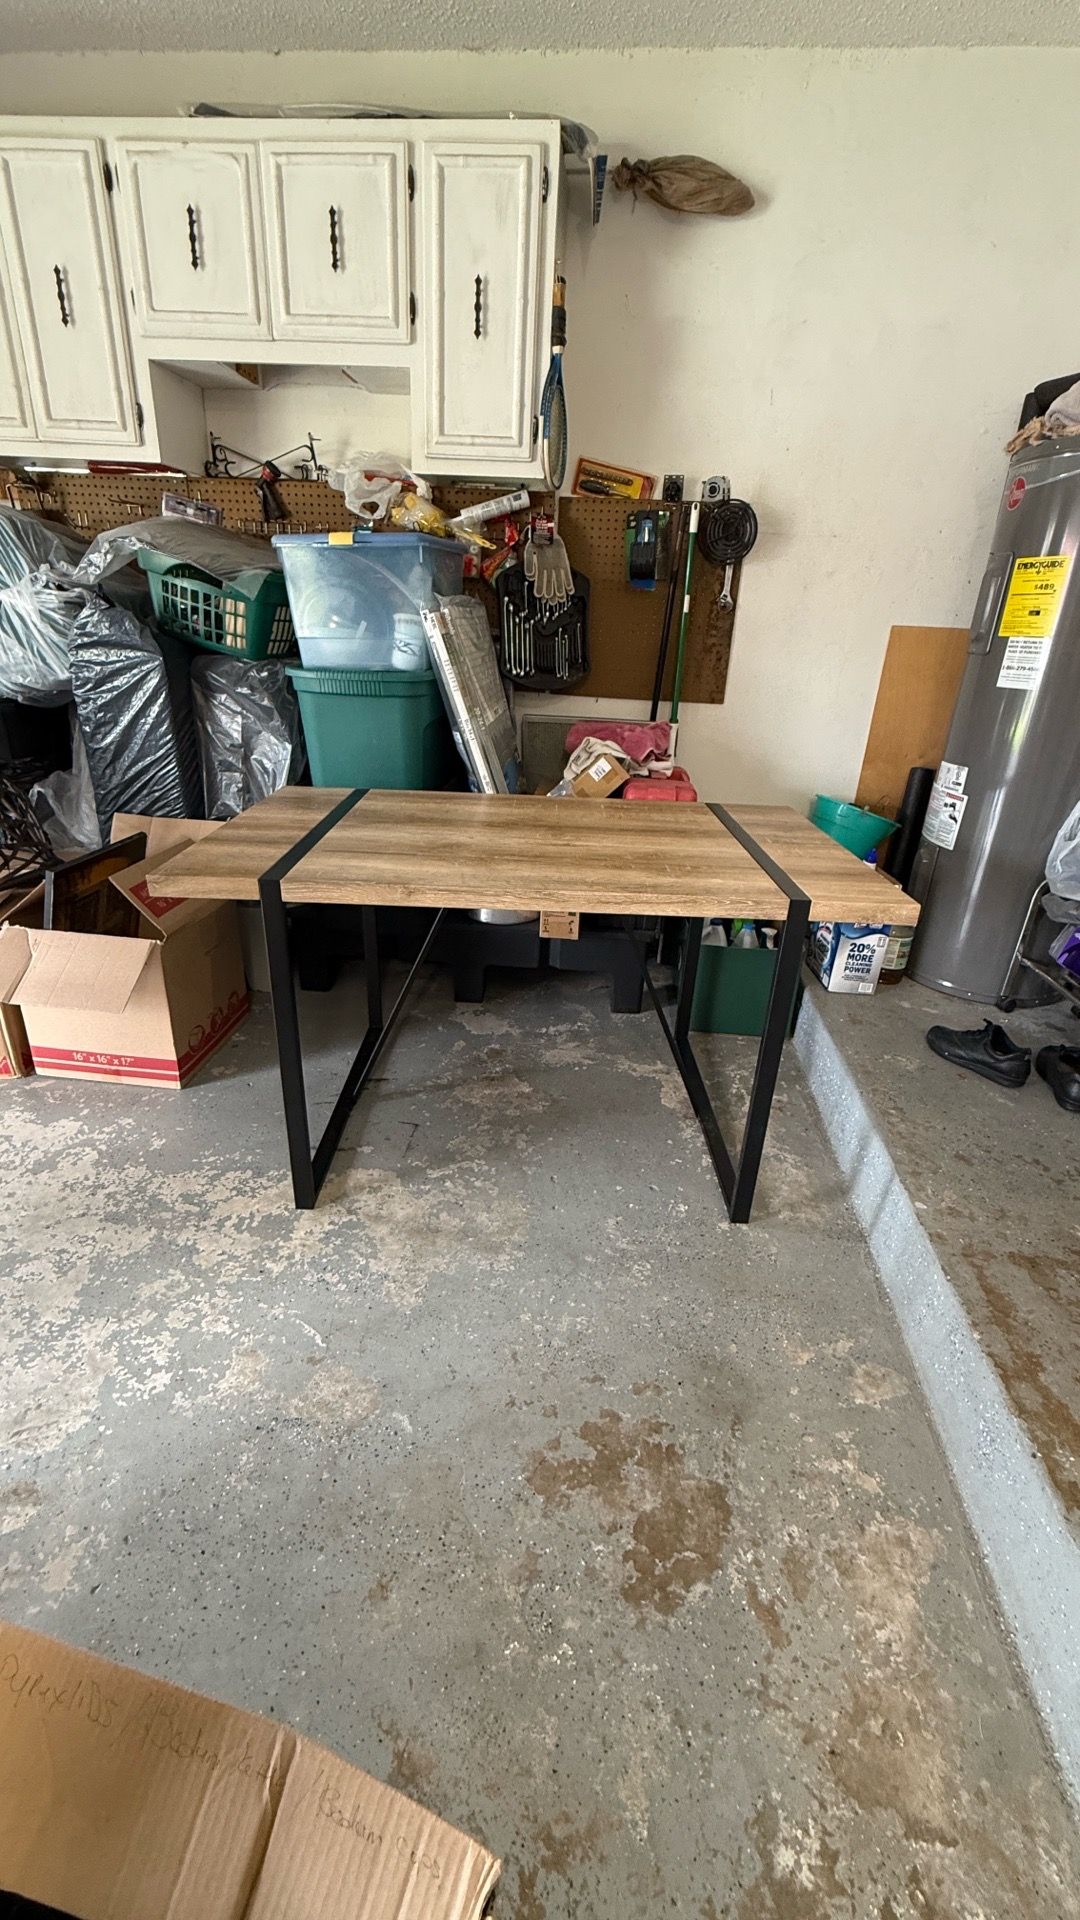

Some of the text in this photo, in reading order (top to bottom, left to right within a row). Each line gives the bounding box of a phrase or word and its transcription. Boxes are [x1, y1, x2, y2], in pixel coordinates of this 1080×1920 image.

[1034, 583, 1055, 591] $489
[849, 942, 876, 955] 20%
[846, 953, 874, 963] MORE
[843, 966, 872, 974] POWER
